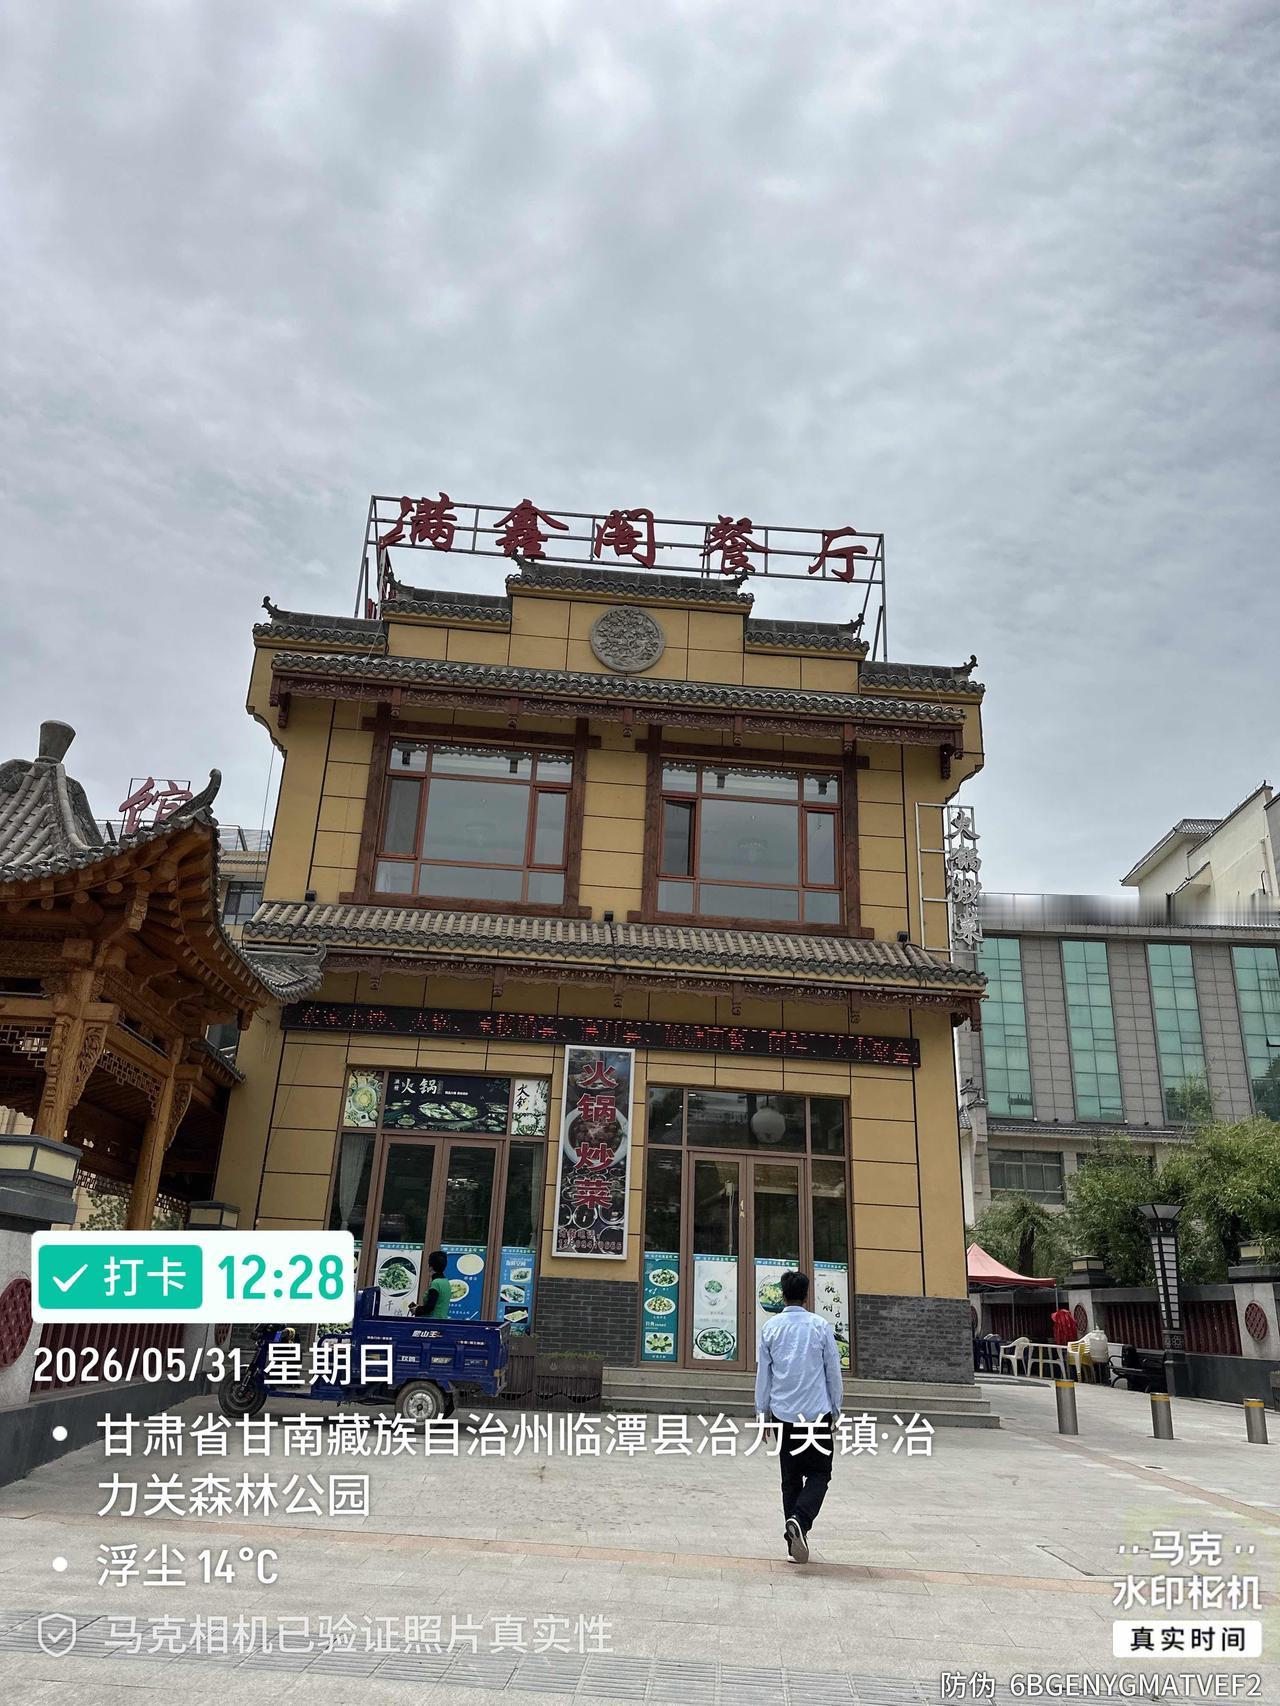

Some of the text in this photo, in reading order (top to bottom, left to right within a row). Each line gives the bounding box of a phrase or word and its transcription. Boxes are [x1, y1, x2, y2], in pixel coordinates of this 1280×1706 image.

[119, 776, 194, 833] 馆
[401, 1078, 438, 1095] 火锅
[571, 1061, 619, 1209] 火锅炒菜
